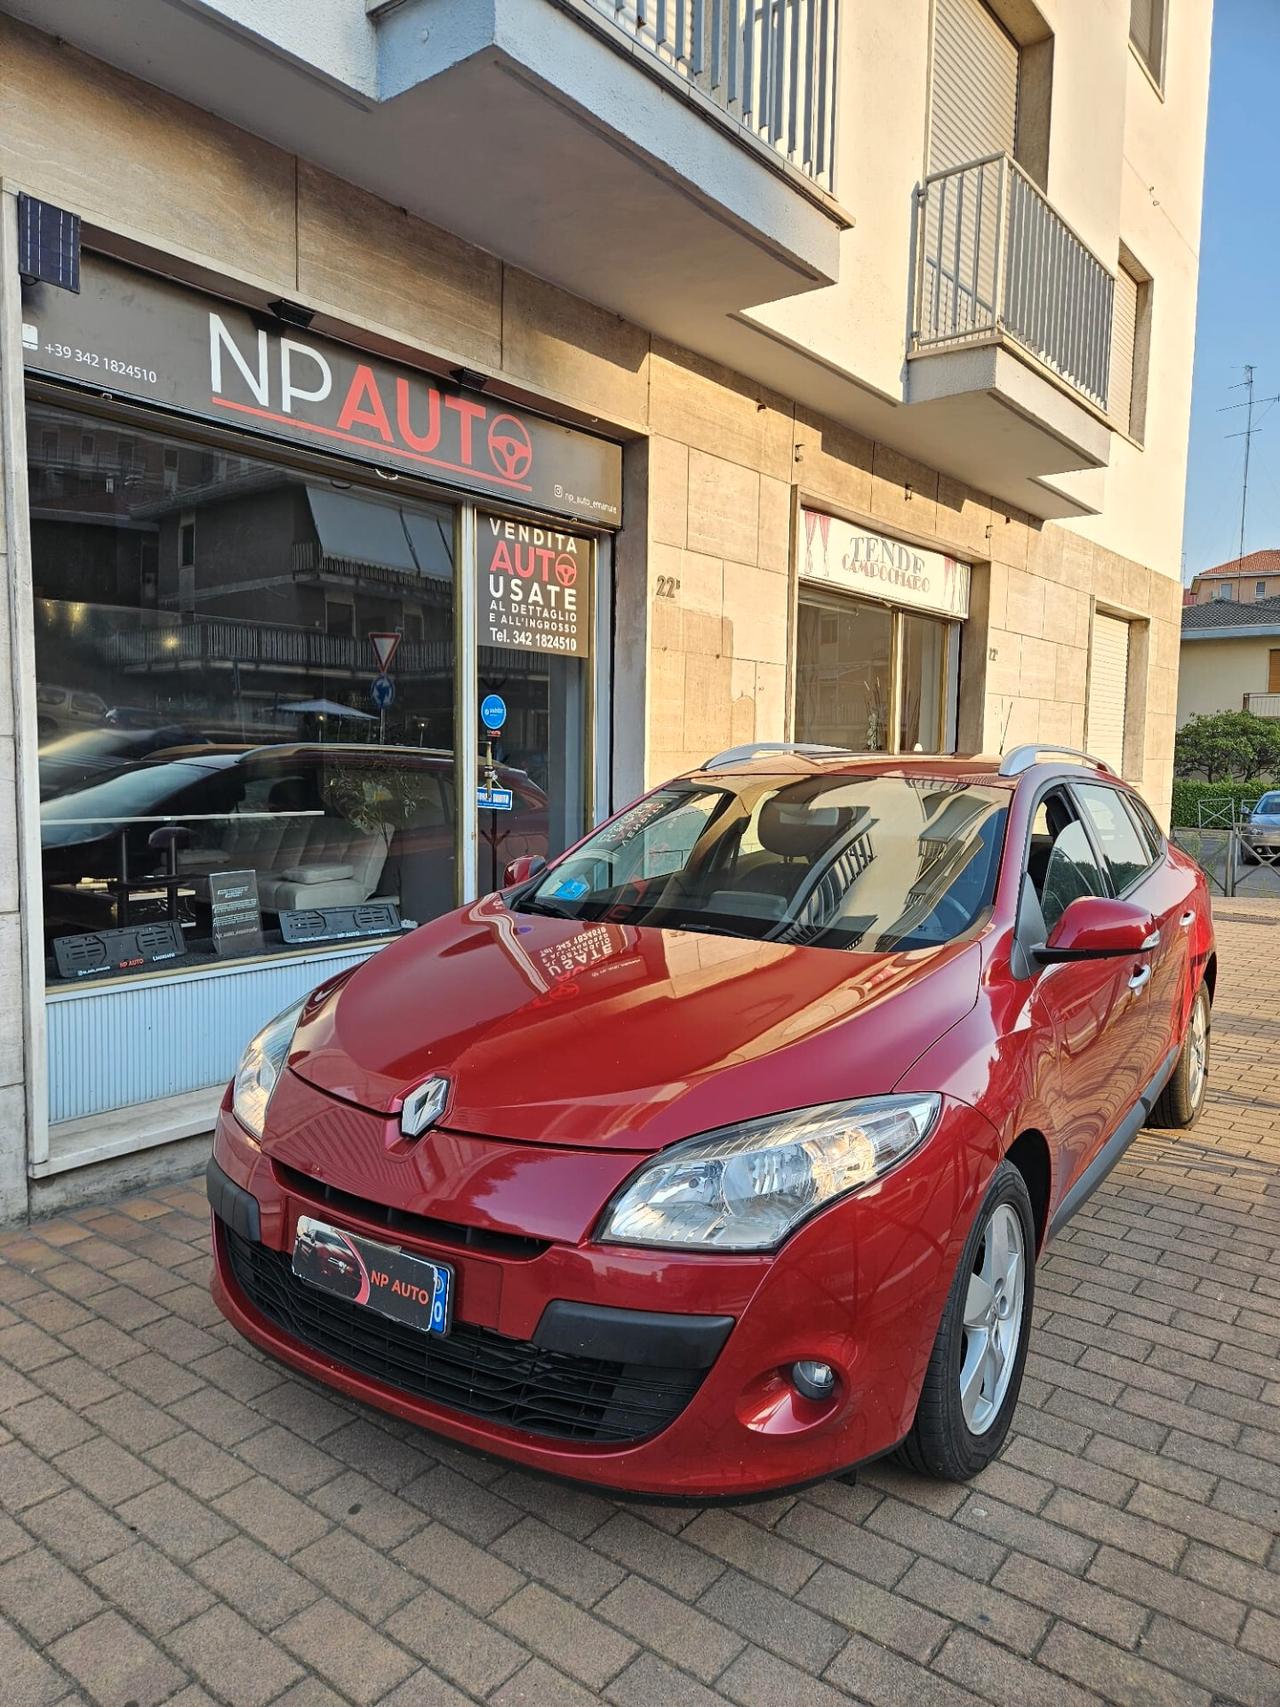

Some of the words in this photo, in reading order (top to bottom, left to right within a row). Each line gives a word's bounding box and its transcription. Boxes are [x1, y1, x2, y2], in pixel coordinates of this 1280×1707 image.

[44, 343, 72, 359] +39
[75, 349, 100, 368] 342
[103, 358, 157, 384] 1824510
[489, 517, 578, 554] VENDITA
[489, 540, 577, 587] AUTO
[489, 574, 577, 611] USATE
[489, 599, 506, 612] AL
[511, 603, 577, 622] DETTAGLIO
[489, 612, 496, 623] E
[500, 614, 577, 634] ALL'INGROSSO
[489, 627, 511, 643] Tel.
[513, 630, 532, 647] 342
[535, 633, 577, 652] 1824510
[371, 1269, 389, 1288] NP
[391, 1279, 429, 1305] AUTO
